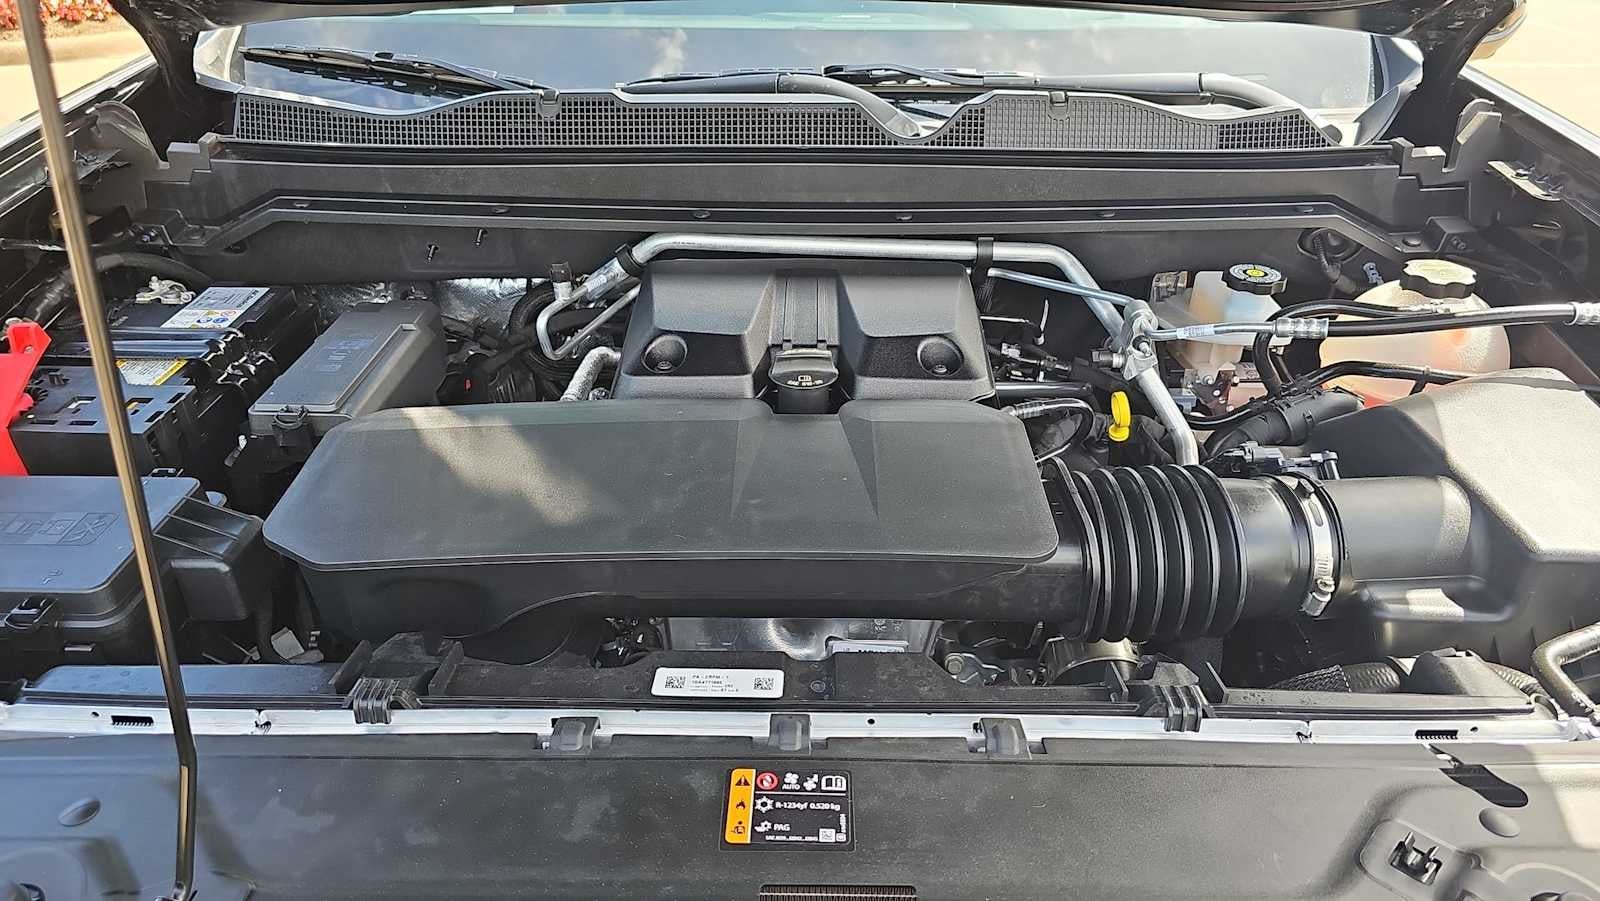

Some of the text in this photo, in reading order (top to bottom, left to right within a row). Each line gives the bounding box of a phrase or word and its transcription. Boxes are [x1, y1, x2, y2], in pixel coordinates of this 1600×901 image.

[775, 802, 841, 811] R-1234yf 0.520 kg
